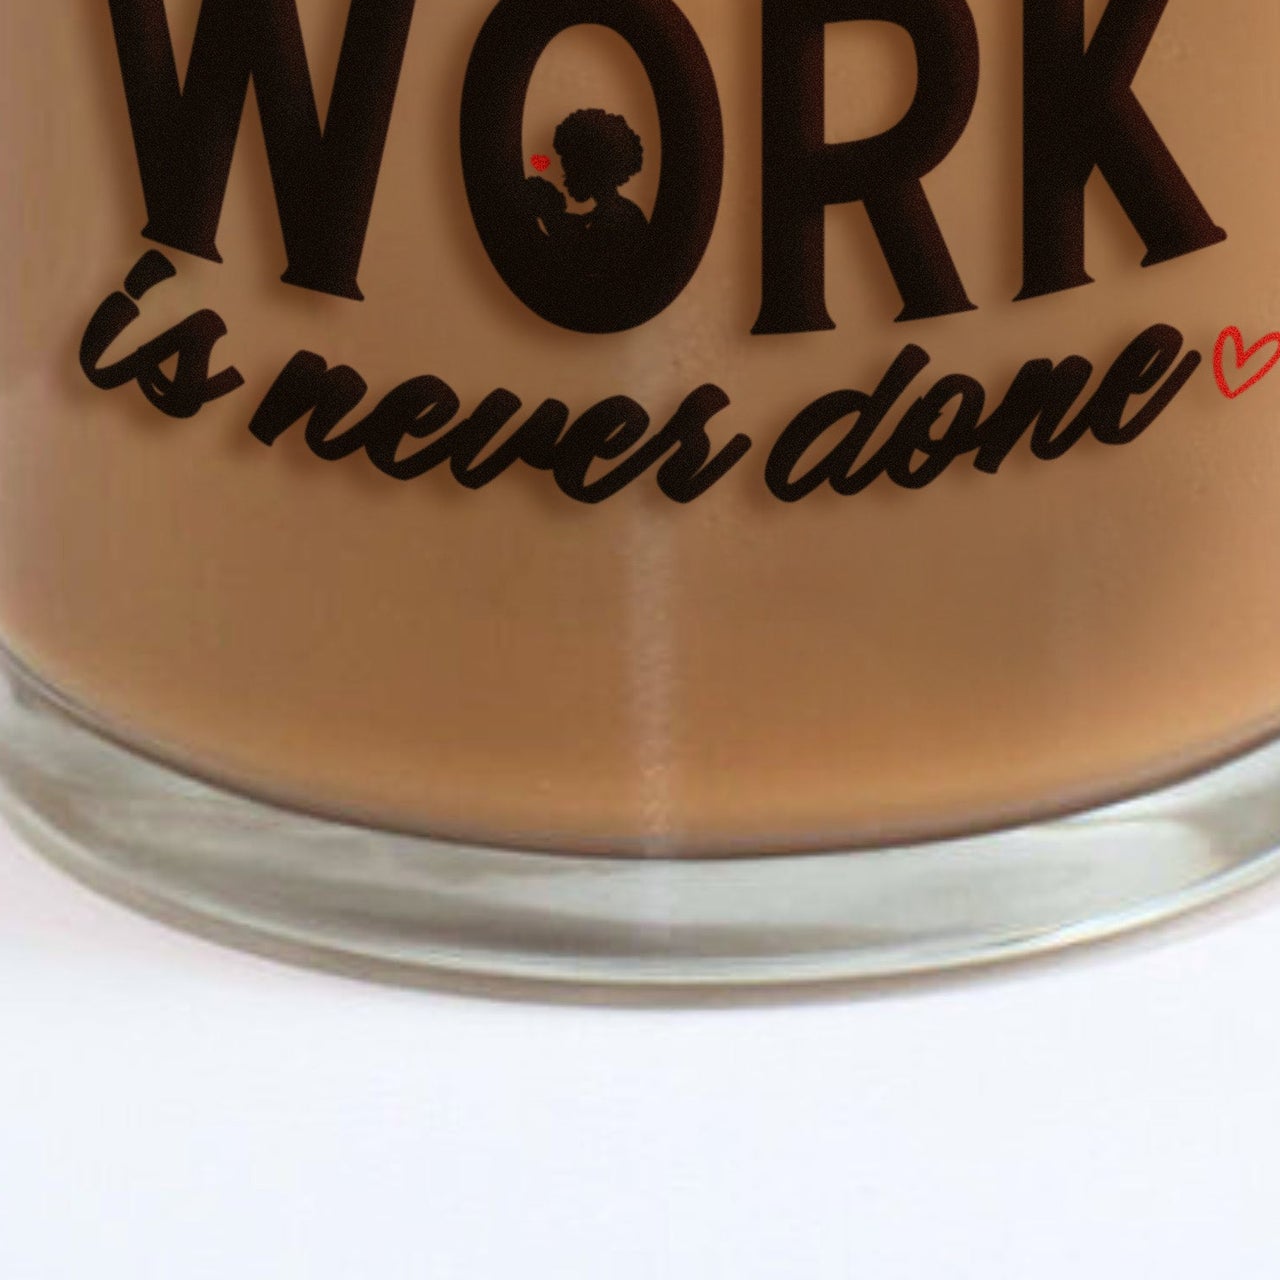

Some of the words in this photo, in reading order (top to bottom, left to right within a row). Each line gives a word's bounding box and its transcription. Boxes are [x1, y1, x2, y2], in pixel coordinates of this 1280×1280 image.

[78, 248, 246, 420] is
[247, 350, 752, 505] never
[763, 322, 1203, 503] done
